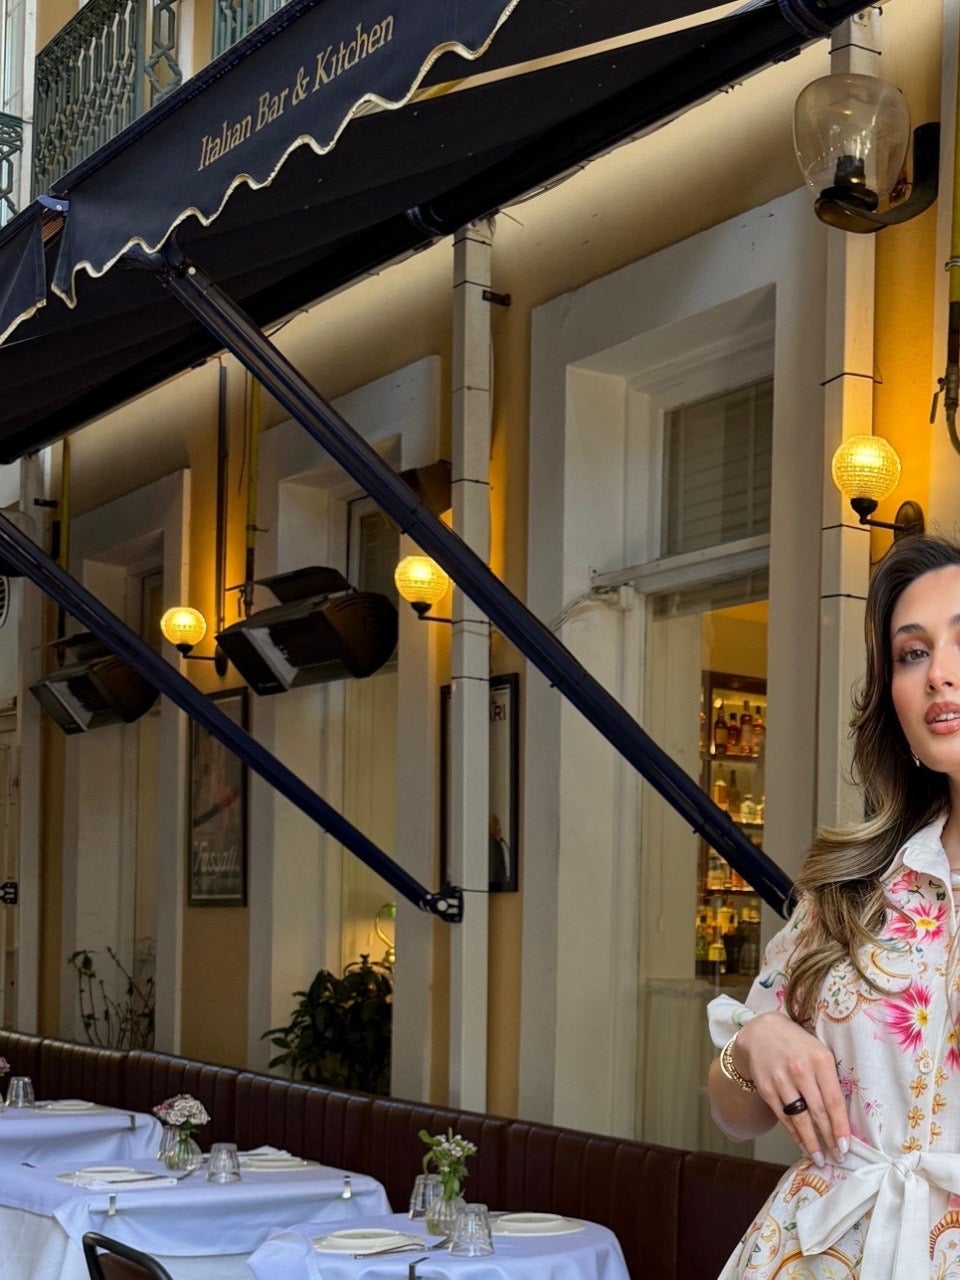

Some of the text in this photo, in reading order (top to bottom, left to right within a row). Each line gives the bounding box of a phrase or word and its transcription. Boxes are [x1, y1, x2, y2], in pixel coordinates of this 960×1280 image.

[198, 15, 394, 172] Italian Bar & Kitchen
